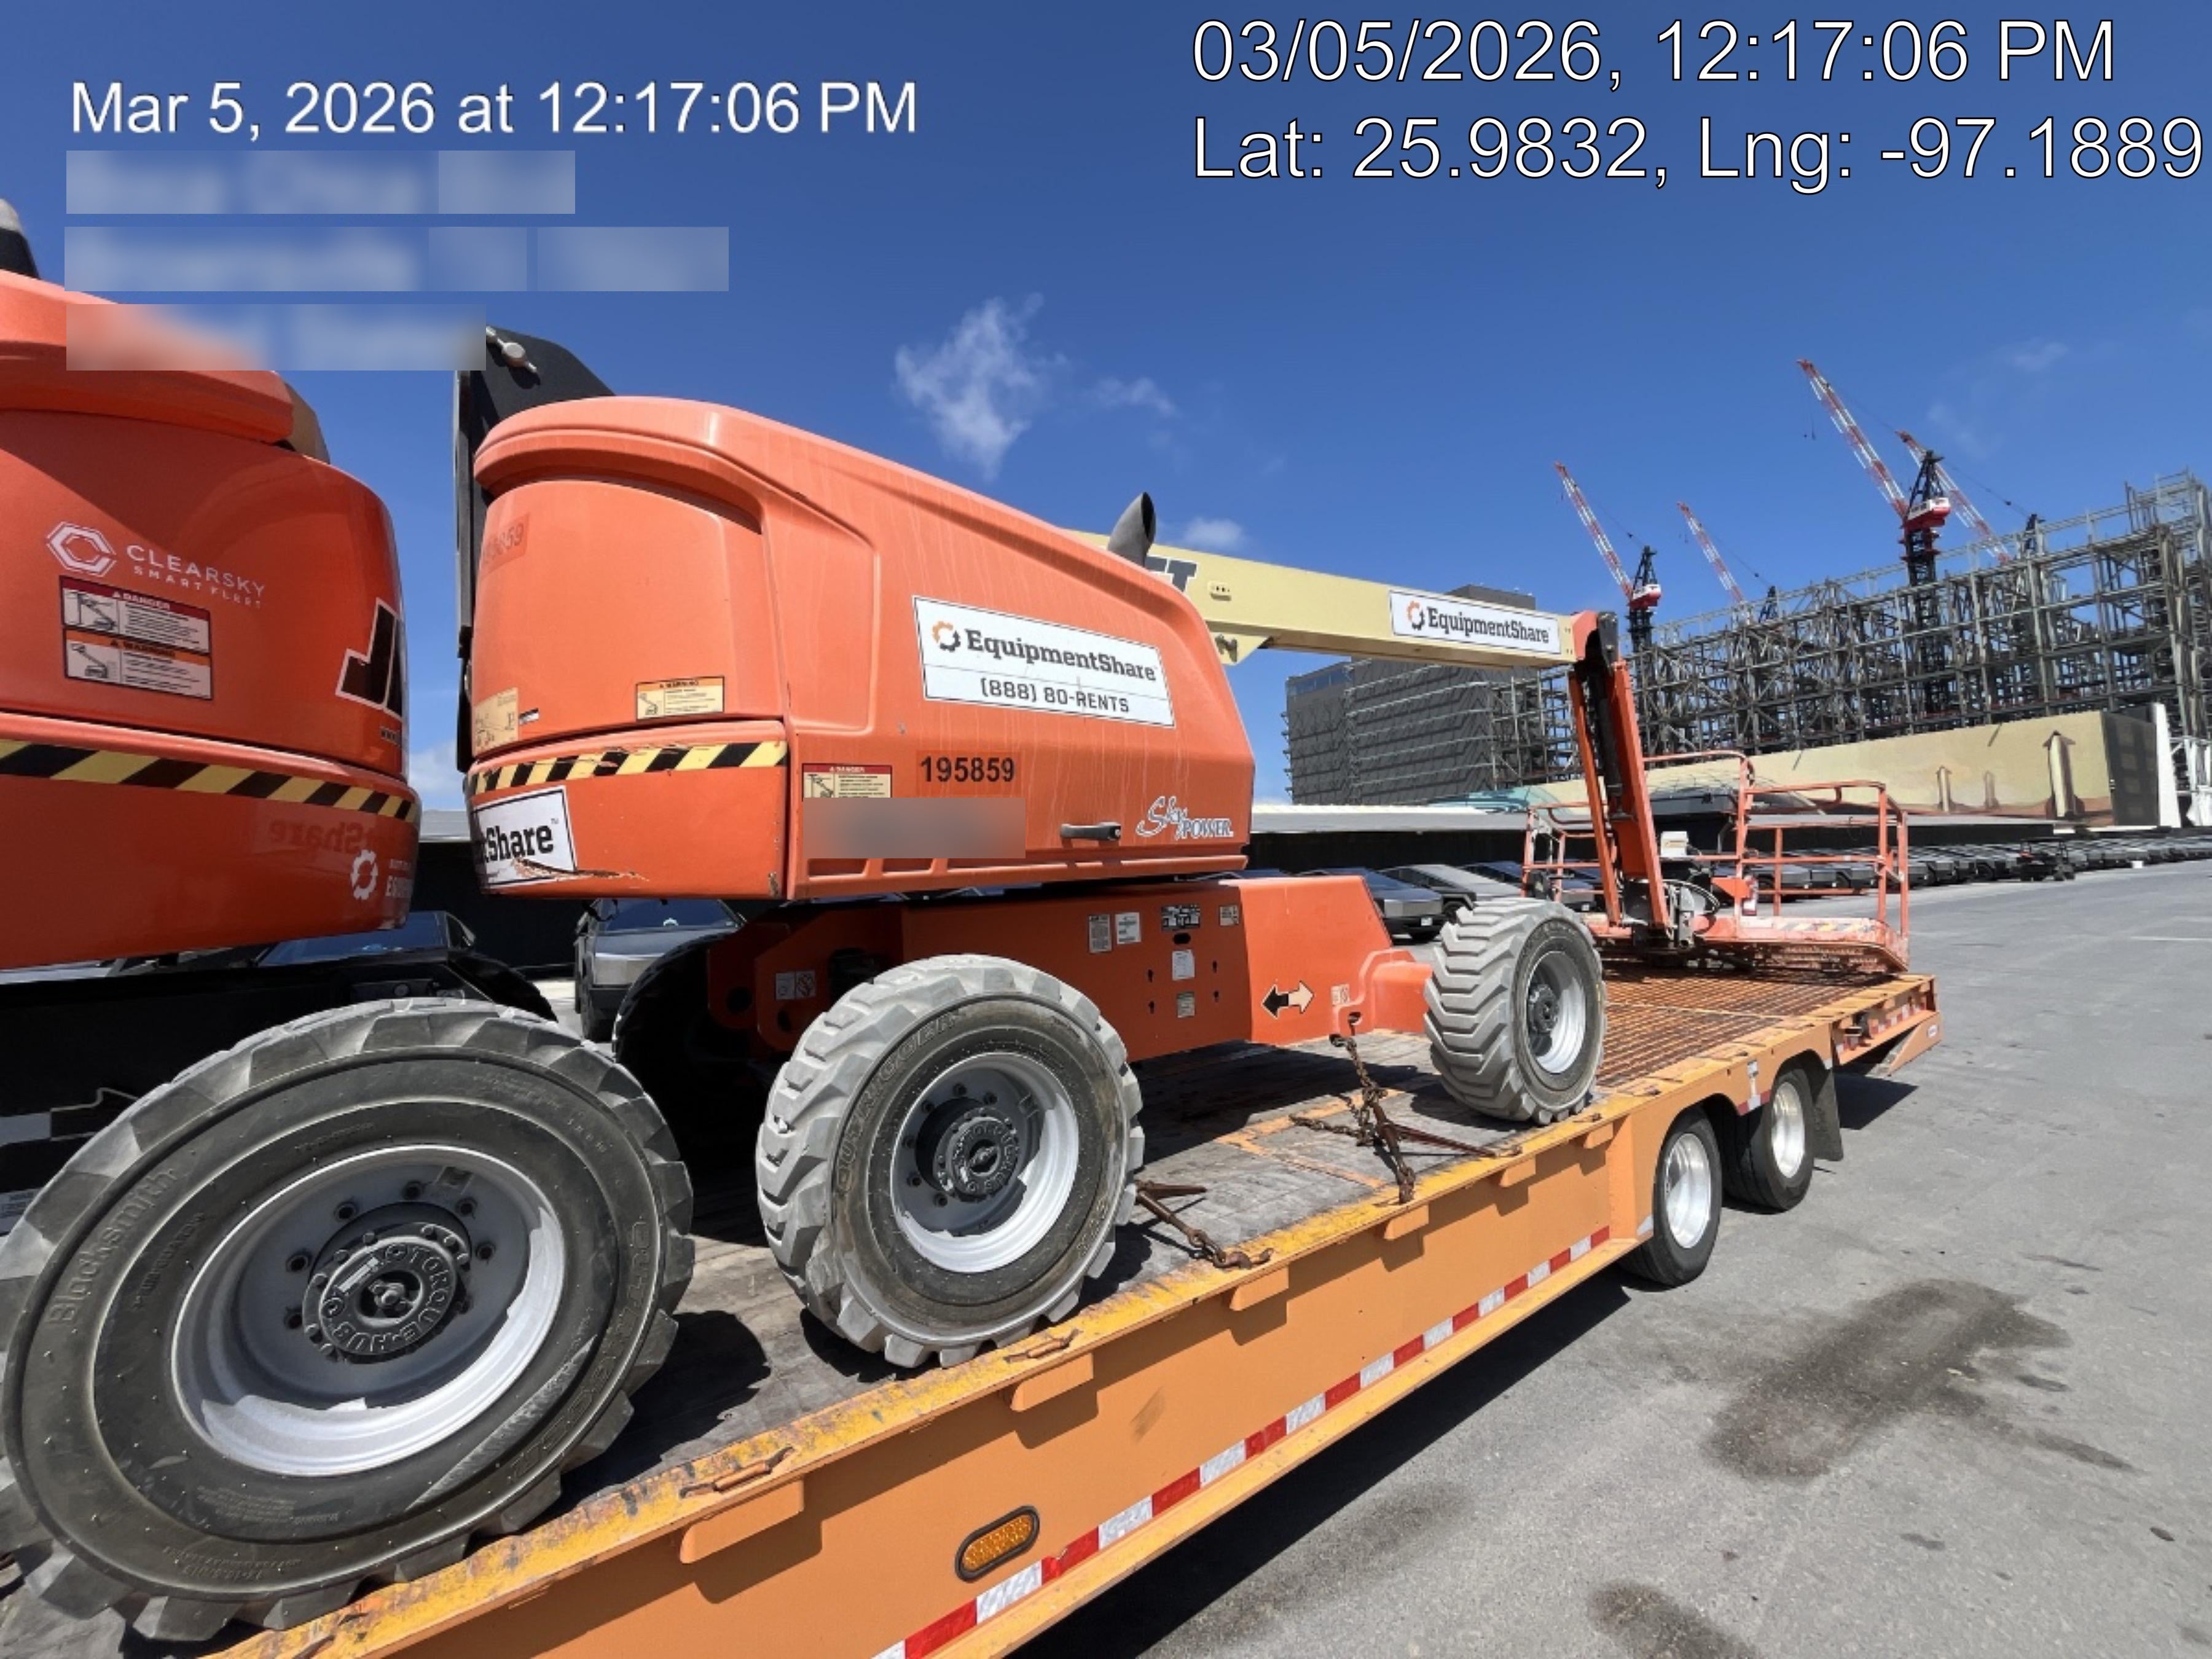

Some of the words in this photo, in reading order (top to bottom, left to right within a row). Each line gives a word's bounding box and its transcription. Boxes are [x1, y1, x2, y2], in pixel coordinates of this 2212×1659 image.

[127, 545, 264, 598] CLEARSKY
[134, 566, 202, 590] SMART
[211, 587, 261, 609] FLEET
[123, 594, 171, 610] DANGER
[1426, 606, 1549, 643] EquipmentShare
[965, 629, 1157, 681] EquipmentShare
[980, 677, 1037, 702] (888)
[1044, 686, 1129, 713] 80-RENTS
[919, 756, 1015, 782] 195859
[481, 825, 554, 862] Share
[49, 1169, 178, 1322] Blacksmith
